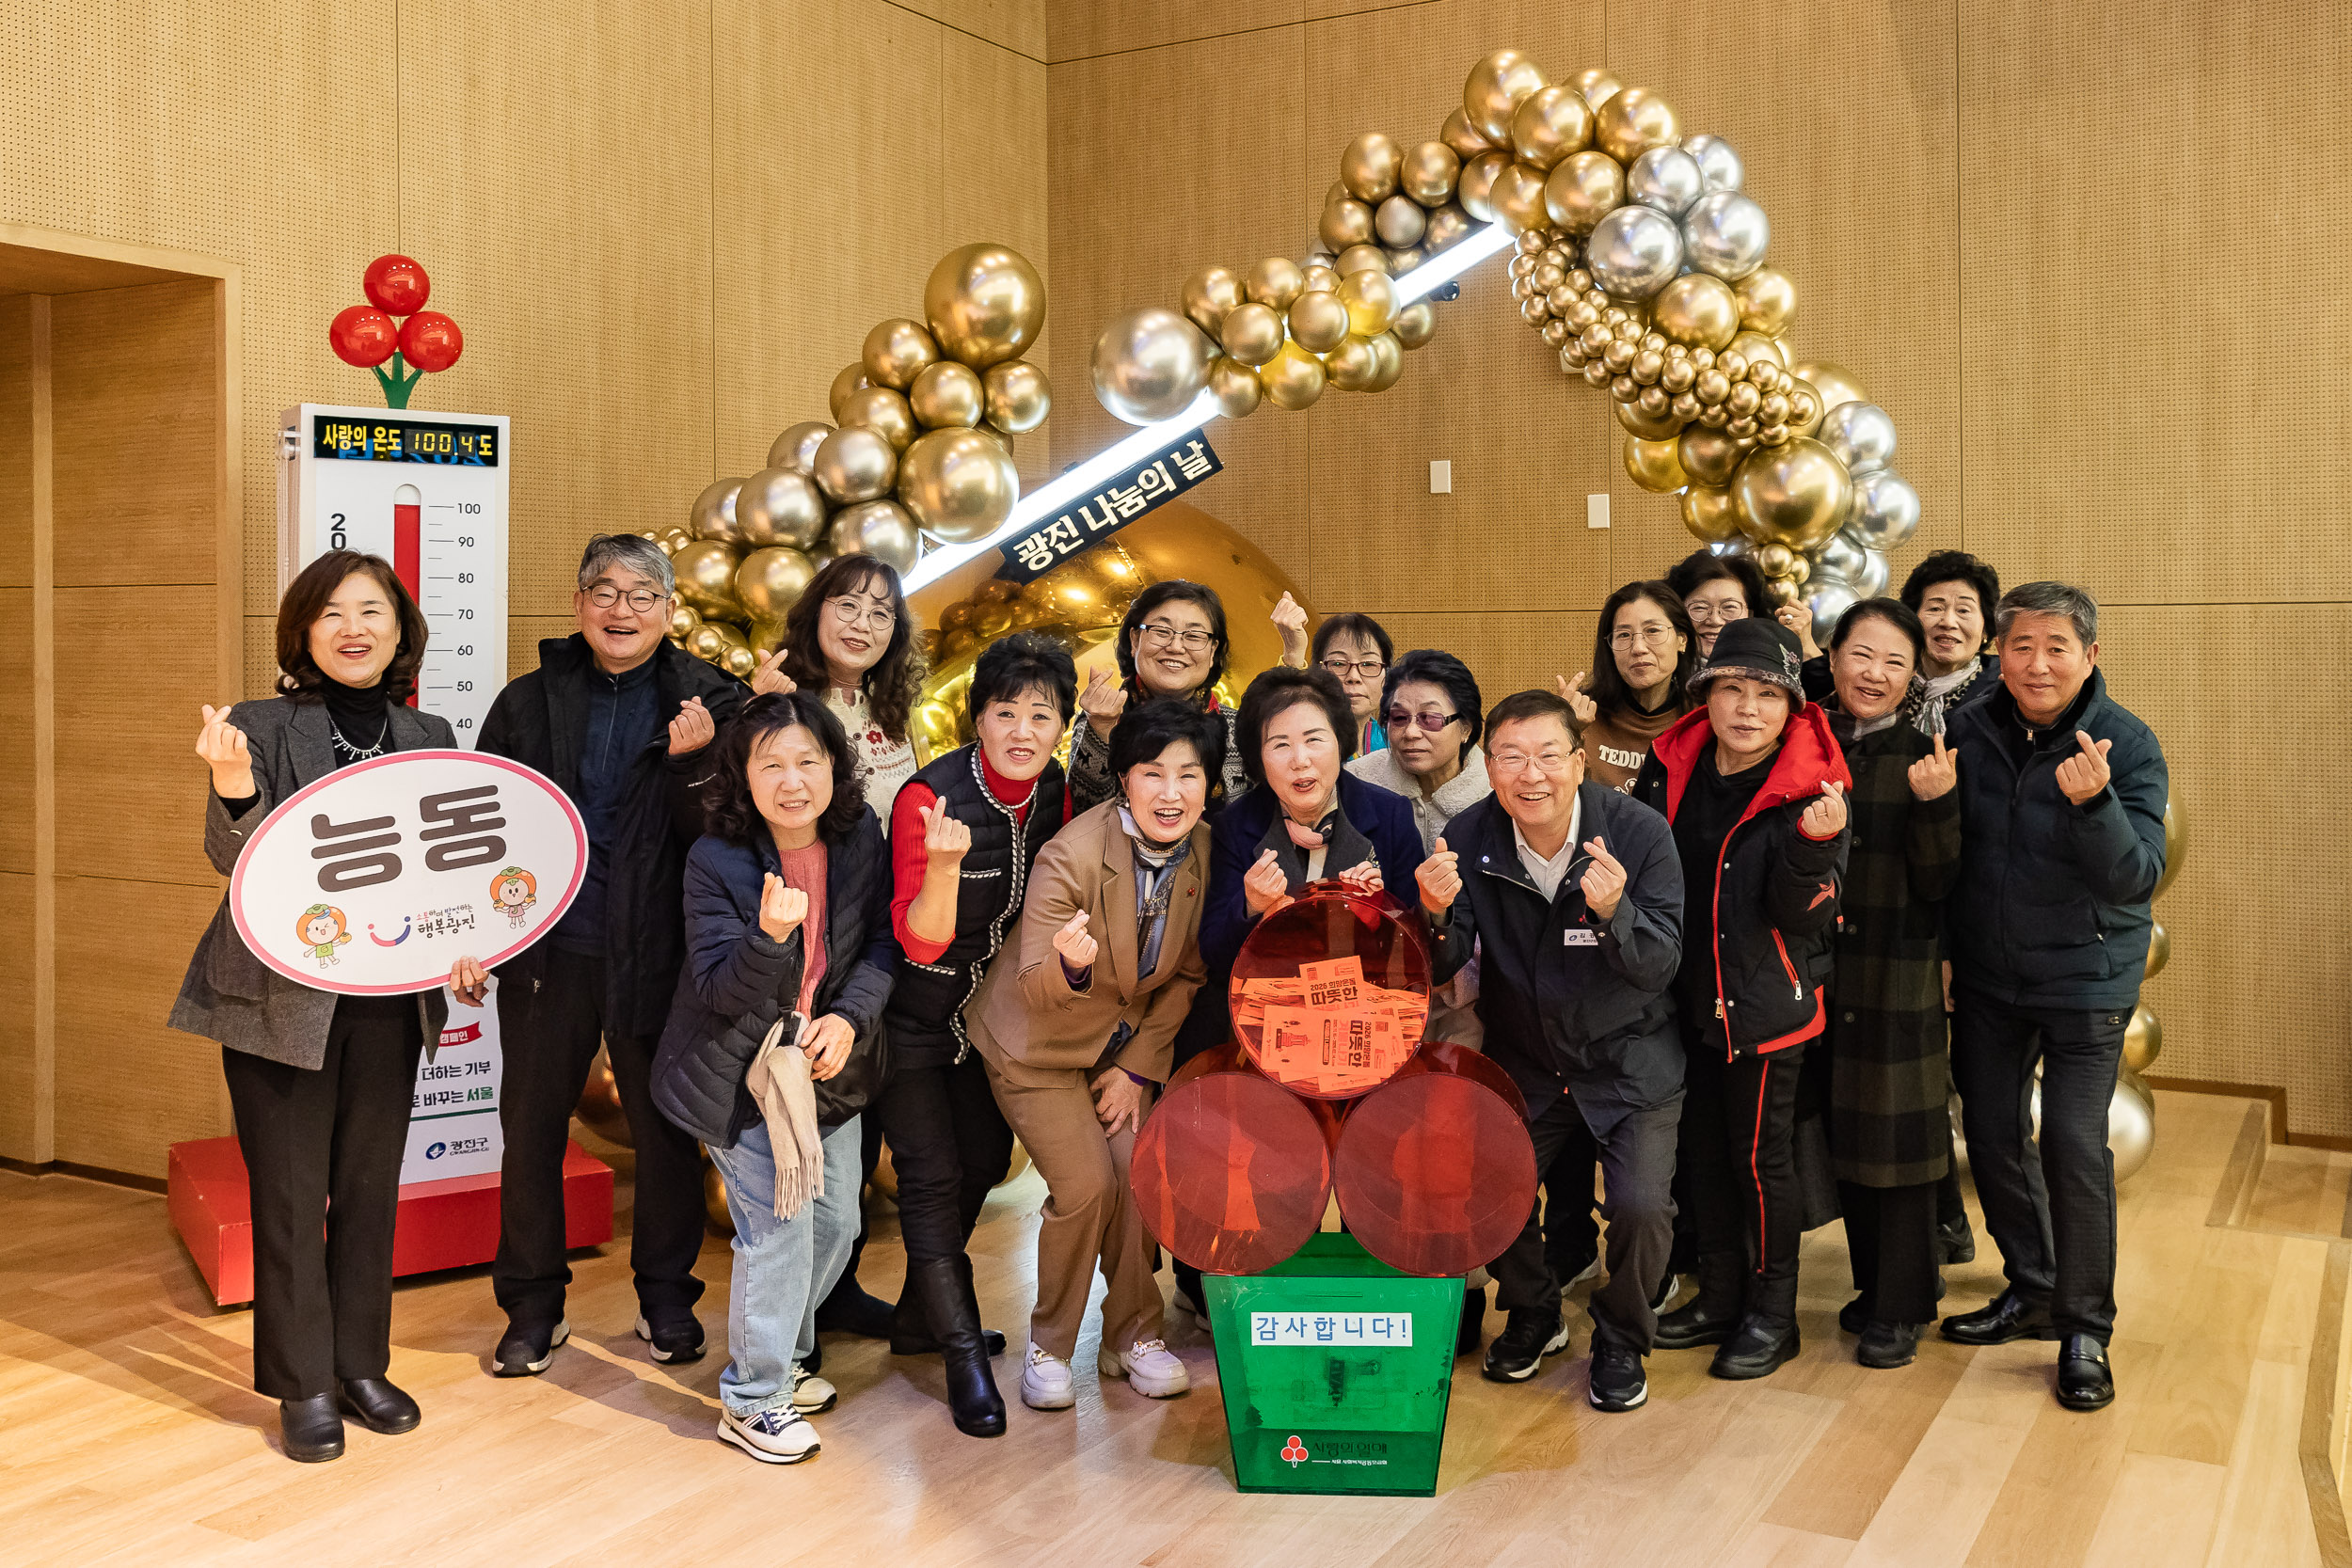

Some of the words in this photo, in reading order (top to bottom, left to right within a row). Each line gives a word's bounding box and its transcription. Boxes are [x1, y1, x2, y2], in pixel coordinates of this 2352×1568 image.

[323, 424, 367, 451] 사랑의
[373, 426, 402, 451] 온도
[457, 503, 481, 515] 100
[1013, 515, 1084, 571] 광진
[1078, 460, 1177, 531] 나눔의
[1170, 440, 1212, 481] 날
[458, 536, 475, 547] 90
[458, 573, 474, 584] 80
[458, 610, 474, 621] 70
[457, 645, 473, 657] 60
[456, 681, 473, 692] 50
[456, 719, 472, 729] 40
[310, 784, 507, 893] 능동
[416, 909, 444, 923] 소통하며
[444, 904, 473, 918] 발전하는
[418, 913, 475, 939] 행복광진
[1310, 982, 1327, 991] 2026
[1311, 986, 1359, 1006] 따뜻한
[1348, 1020, 1363, 1068] 따뜻한
[421, 1065, 462, 1081] 더하는
[465, 1060, 491, 1075] 기부
[423, 1091, 464, 1107] 바꾸는
[467, 1086, 494, 1101] 서울
[450, 1137, 488, 1151] 광진구
[1256, 1316, 1407, 1341] 감사합니다!
